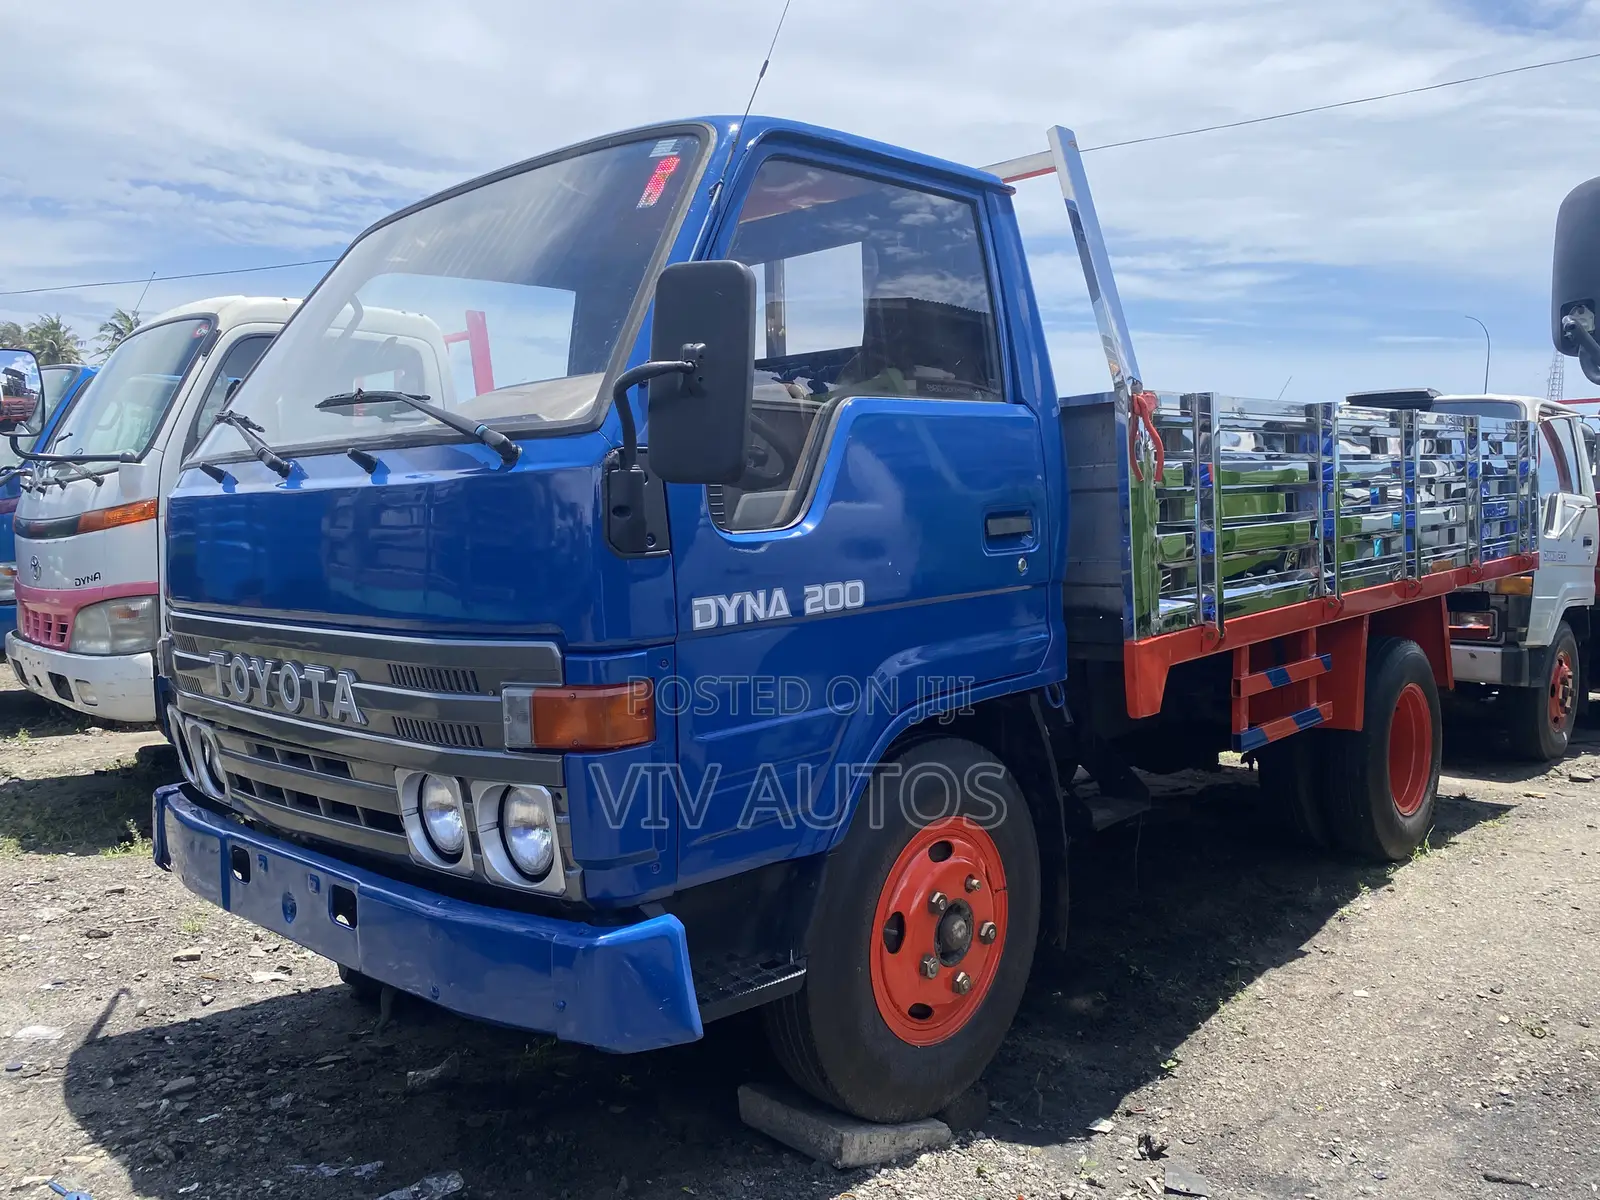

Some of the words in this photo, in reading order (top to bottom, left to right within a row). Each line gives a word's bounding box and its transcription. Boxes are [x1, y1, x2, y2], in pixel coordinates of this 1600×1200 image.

[74, 571, 102, 587] DYNA
[691, 587, 793, 631] DYNA
[803, 579, 866, 616] 200
[209, 650, 369, 726] TOYOTA
